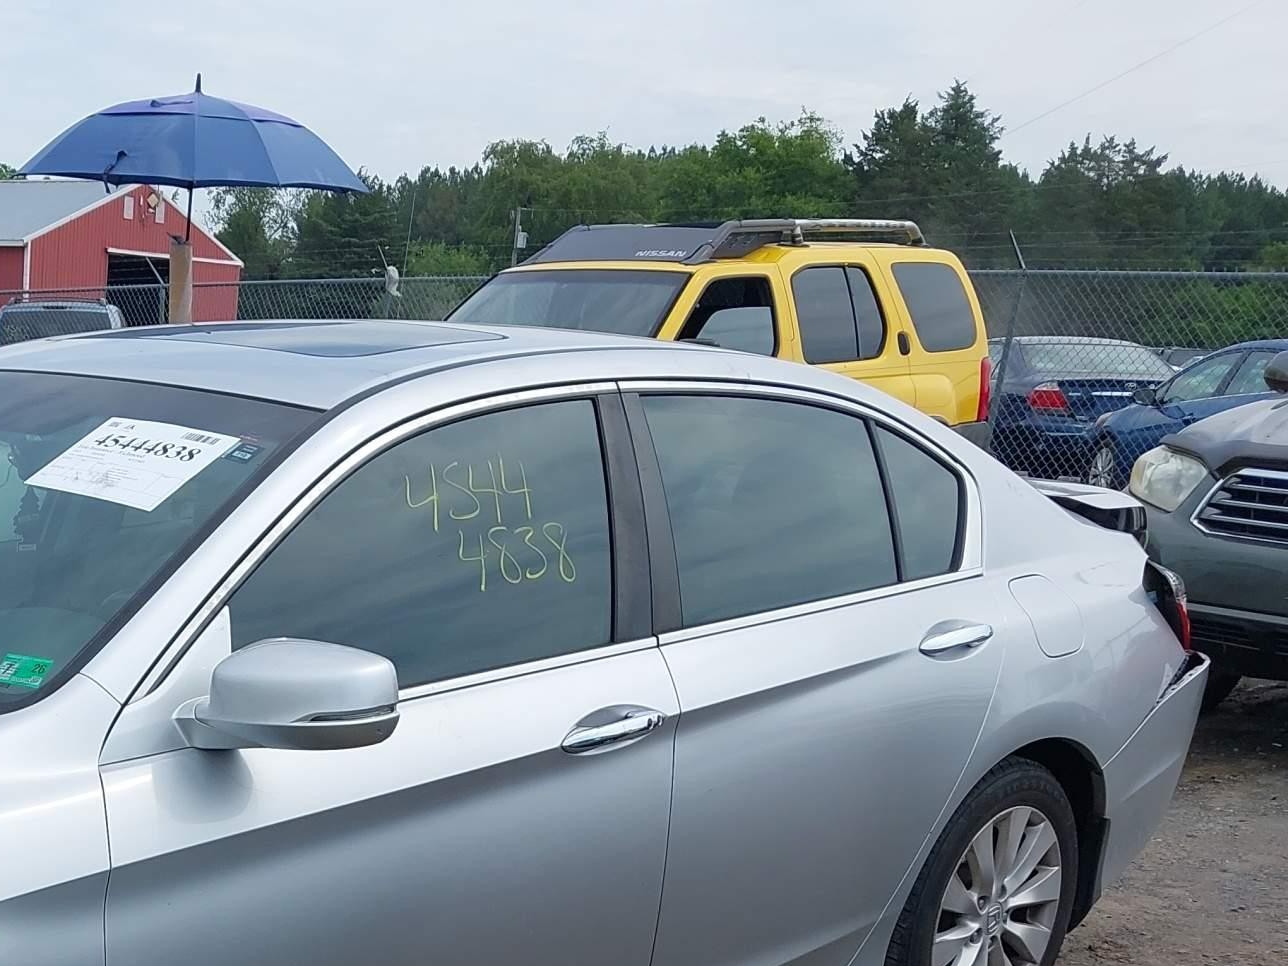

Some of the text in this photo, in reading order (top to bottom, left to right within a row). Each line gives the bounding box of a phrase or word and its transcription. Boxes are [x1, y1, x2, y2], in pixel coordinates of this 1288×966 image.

[94, 432, 203, 463] 45444838
[404, 451, 534, 534] 4544
[457, 520, 578, 593] 4838
